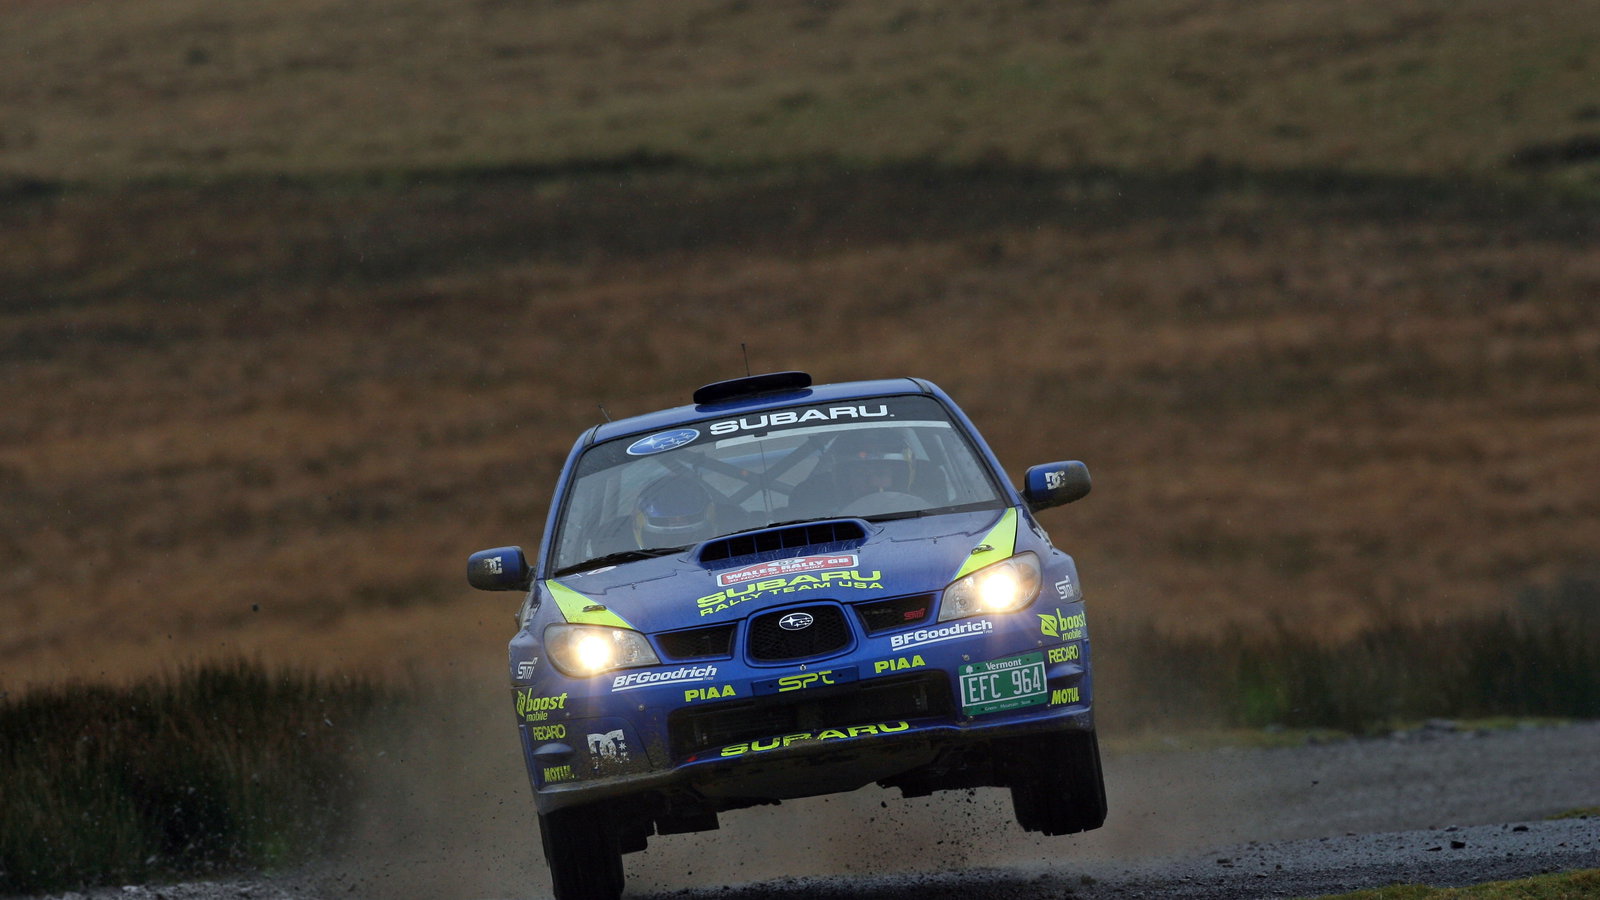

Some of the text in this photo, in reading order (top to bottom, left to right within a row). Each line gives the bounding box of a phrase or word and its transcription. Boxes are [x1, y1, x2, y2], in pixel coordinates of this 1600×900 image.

[710, 405, 888, 435] SUBARU
[726, 567, 777, 580] WALES
[781, 560, 824, 570] RALLY
[697, 570, 881, 608] SUBARU
[700, 581, 884, 617] RALLY TEAM USA
[1056, 608, 1087, 632] boost
[890, 620, 993, 647] BFGoodrich
[1062, 630, 1082, 641] mobile
[1048, 644, 1079, 664] RECARO
[874, 655, 926, 674] PIAA
[985, 658, 1022, 671] Vermont
[612, 665, 718, 688] BFGoodrich
[968, 666, 1041, 702] EFC 964
[526, 688, 568, 712] boost
[684, 684, 736, 702] PIAA
[1050, 687, 1080, 705] MOTUL
[526, 711, 548, 722] mobile
[532, 724, 566, 741] RECARO
